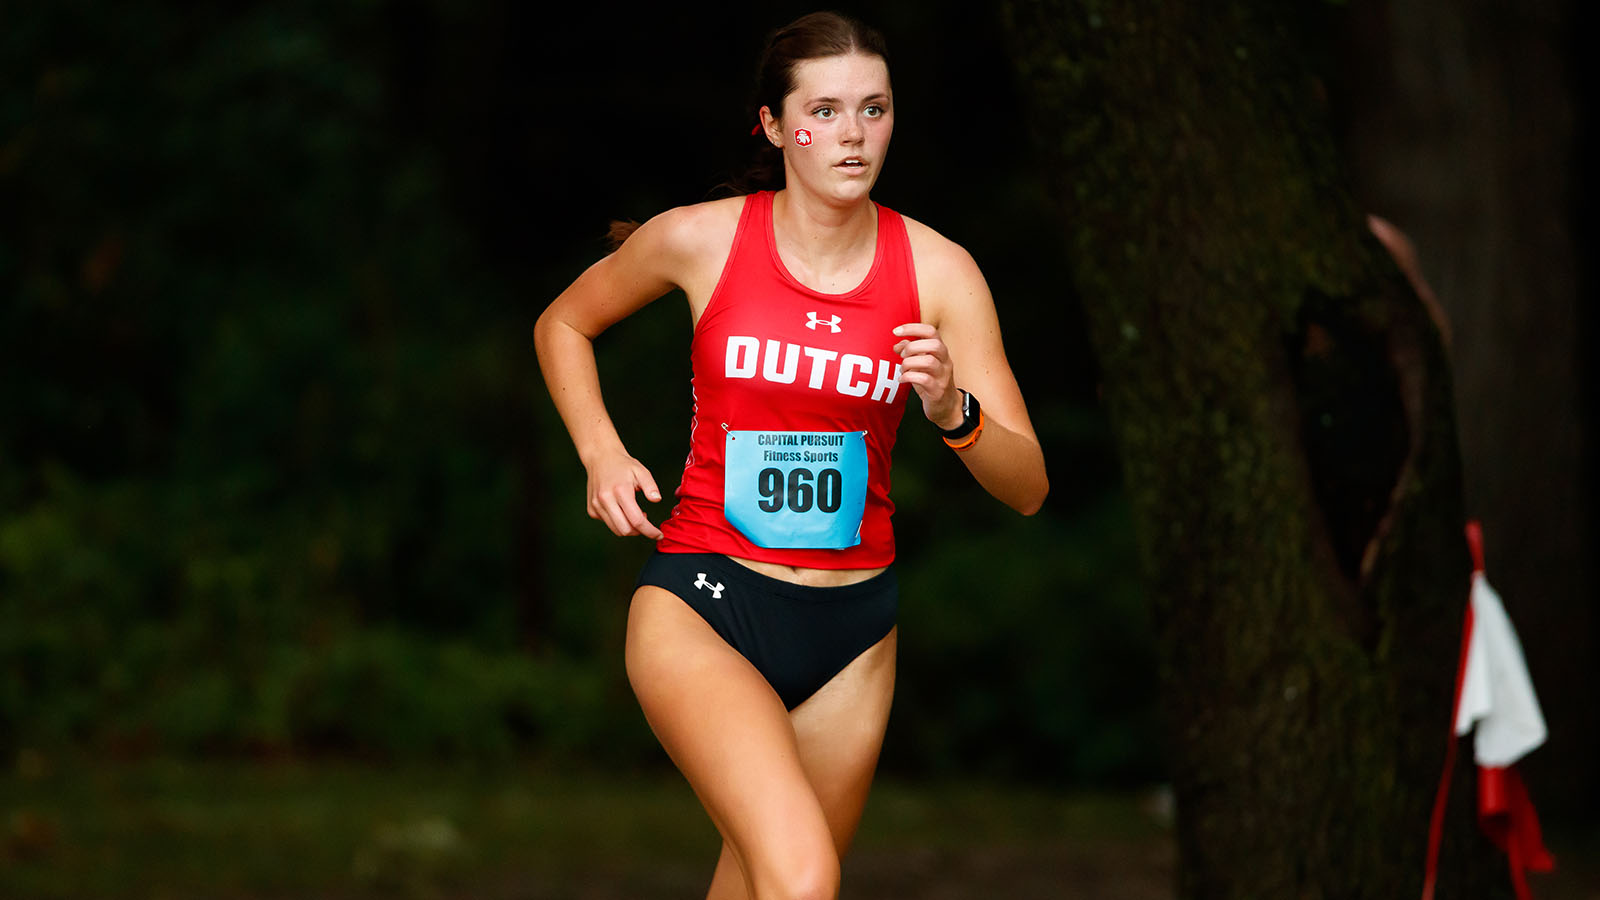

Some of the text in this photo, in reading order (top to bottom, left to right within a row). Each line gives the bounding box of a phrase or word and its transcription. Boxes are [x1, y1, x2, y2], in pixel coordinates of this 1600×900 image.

[725, 336, 902, 404] DUTCH
[758, 434, 845, 446] CAPITAL PURSUIT
[763, 450, 838, 463] Fitness Sports
[758, 467, 842, 513] 960
